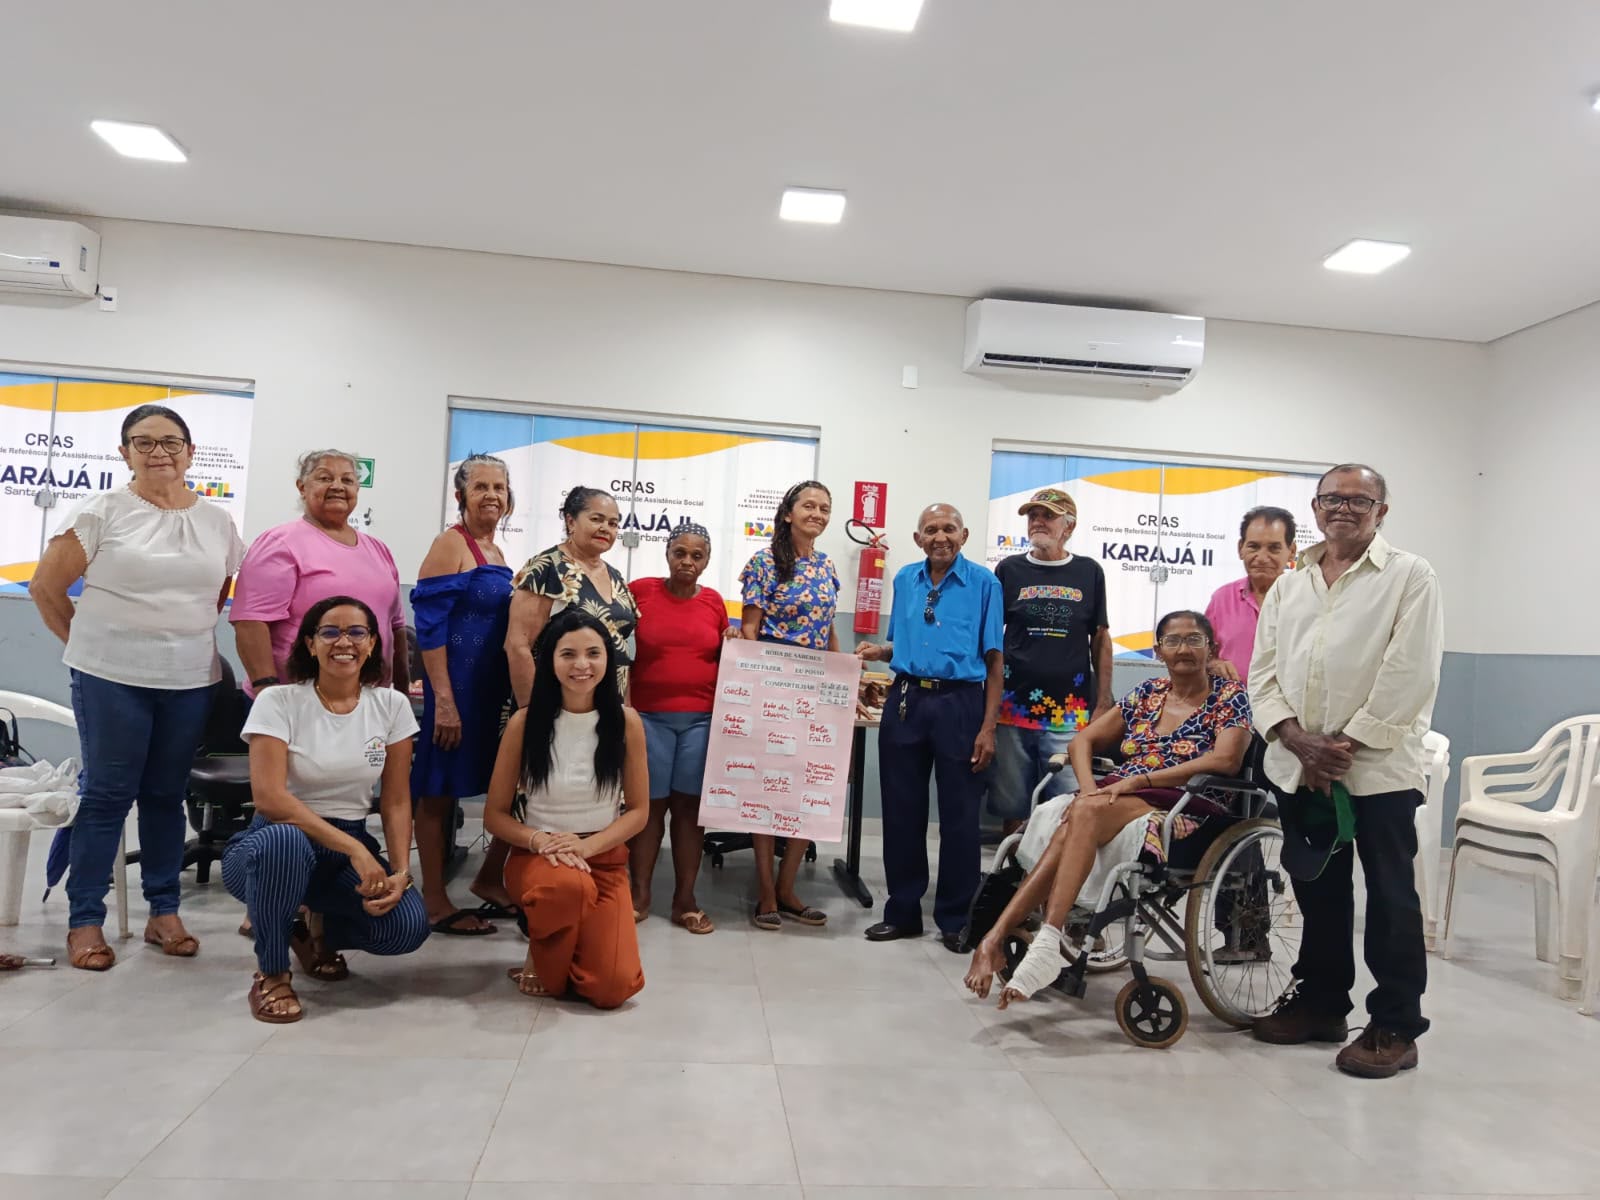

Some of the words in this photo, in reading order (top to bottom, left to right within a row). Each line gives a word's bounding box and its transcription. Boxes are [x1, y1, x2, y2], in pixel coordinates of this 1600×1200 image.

[25, 433, 74, 449] CRAS
[0, 463, 92, 490] ARAJÁ
[99, 471, 113, 490] II
[610, 479, 655, 494] CRAS
[644, 496, 682, 505] Assistência
[683, 499, 704, 507] Social
[1137, 514, 1179, 529] CRAS
[744, 522, 774, 537] BRA
[1092, 525, 1113, 533] Centro
[1124, 527, 1157, 536] Referência
[1169, 531, 1205, 539] Assistência
[1206, 532, 1226, 540] Social
[1102, 541, 1196, 566] KARAJÁ
[1202, 549, 1214, 567] II
[1121, 562, 1150, 573] Santa
